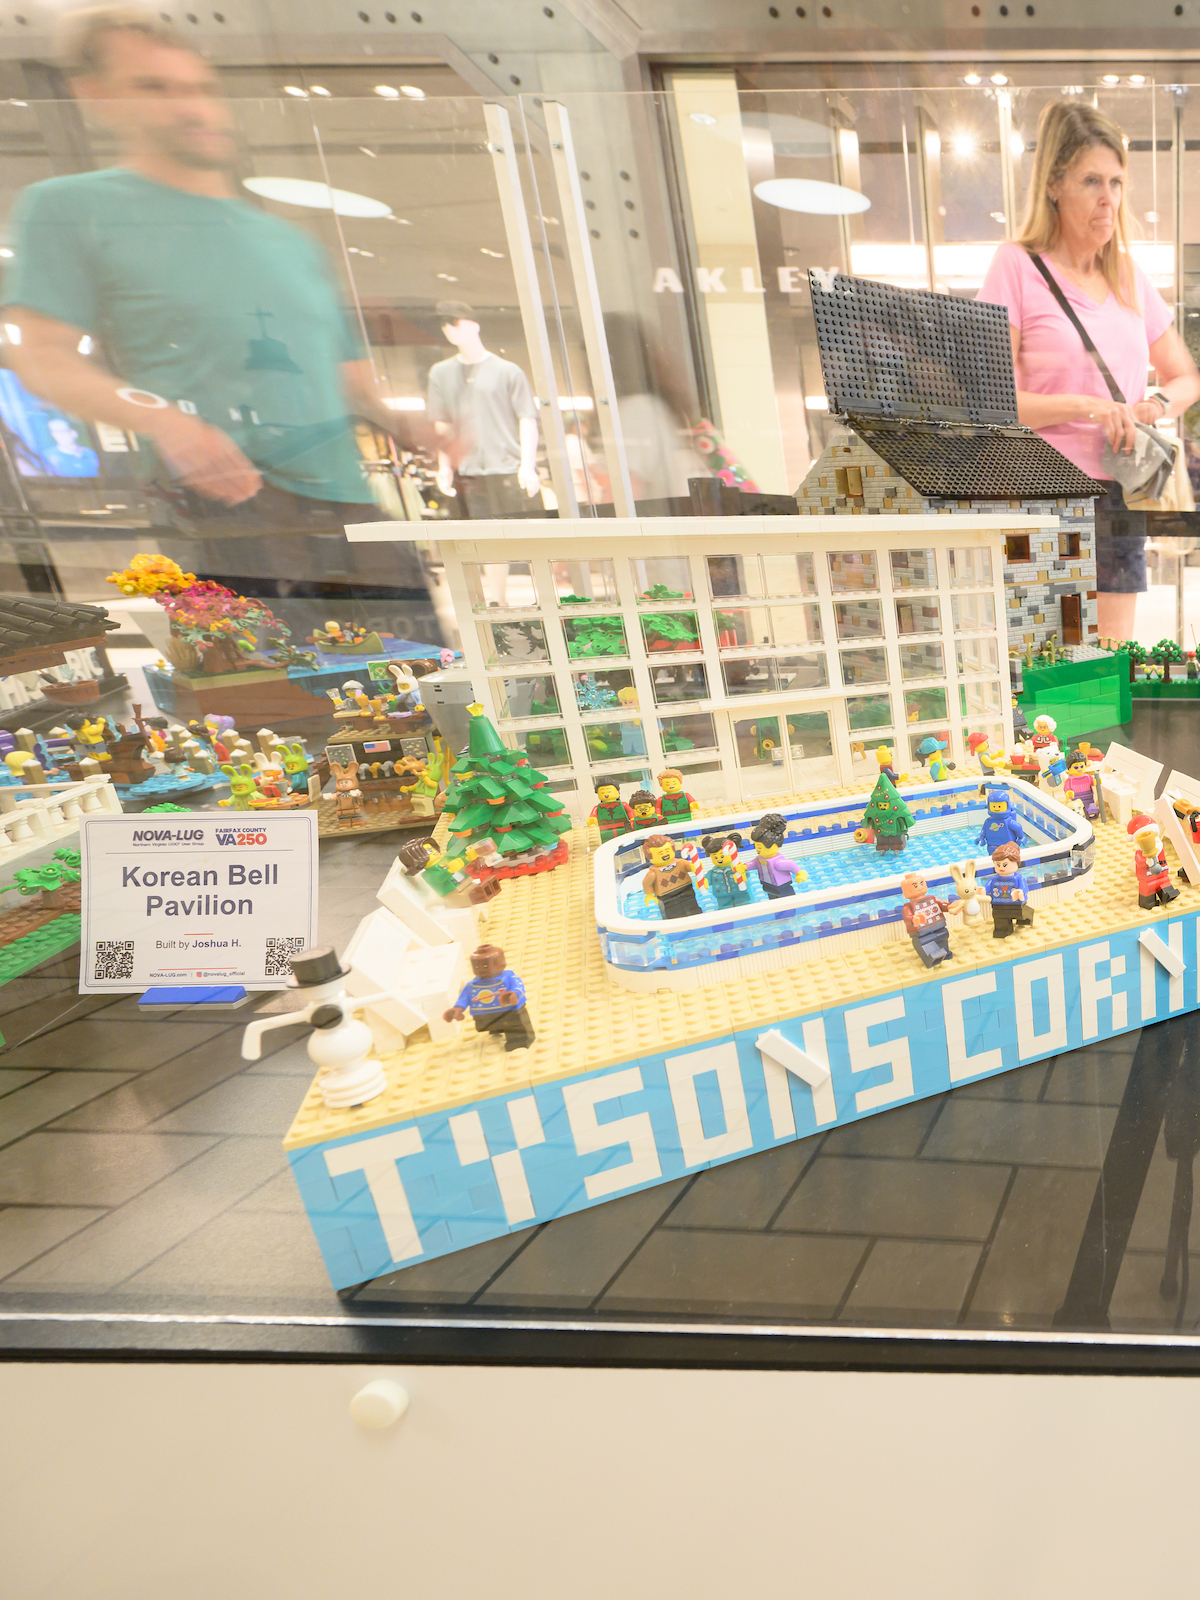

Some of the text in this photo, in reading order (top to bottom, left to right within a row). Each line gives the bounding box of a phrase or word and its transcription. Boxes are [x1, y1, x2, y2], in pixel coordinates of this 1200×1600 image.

[133, 830, 204, 841] NOVA-LUG
[215, 832, 267, 846] VA250
[122, 864, 278, 887] Korean Bell
[146, 895, 253, 916] Pavilion
[178, 941, 189, 950] by
[192, 940, 228, 948] Joshua
[232, 939, 241, 947] H.
[202, 970, 246, 978] @novalug_official
[324, 995, 915, 1264] TYSONS
